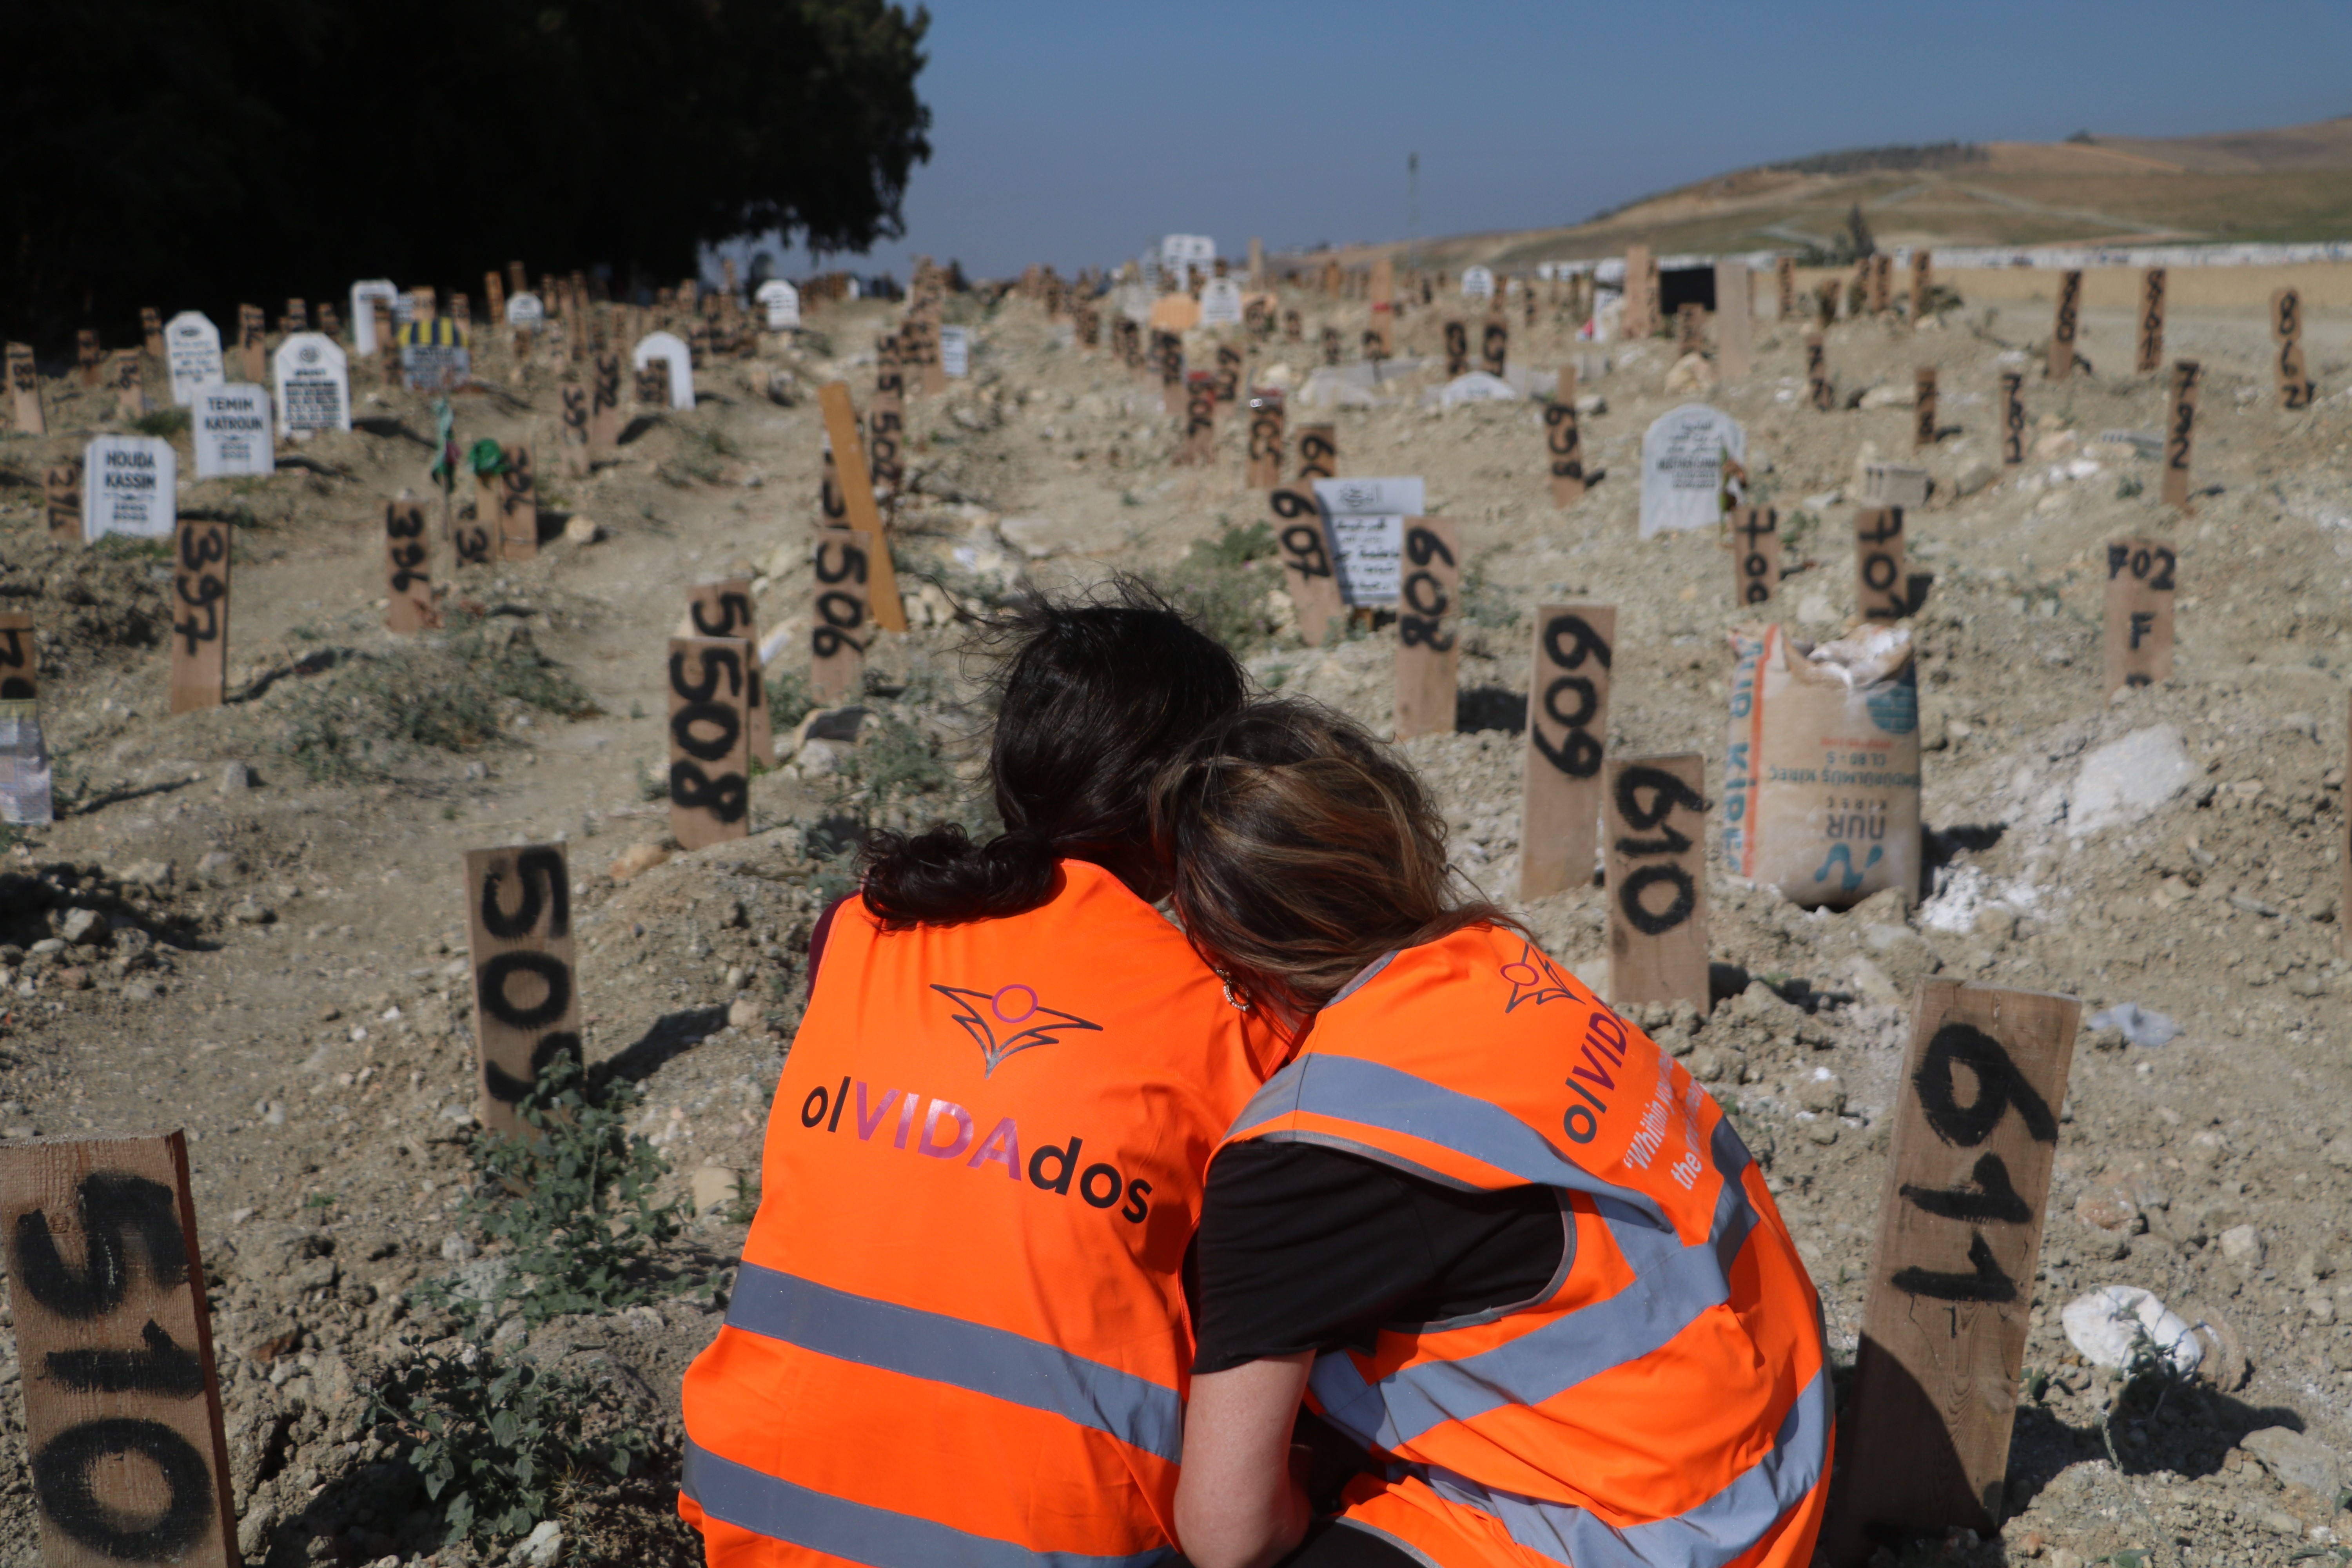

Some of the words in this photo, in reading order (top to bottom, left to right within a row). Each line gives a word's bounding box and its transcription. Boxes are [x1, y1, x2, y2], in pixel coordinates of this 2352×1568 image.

[105, 451, 156, 467] HOUDA
[175, 526, 225, 657] 397
[814, 542, 868, 658] 506
[1270, 489, 1331, 587] 607
[1402, 526, 1456, 652] 608
[670, 647, 748, 823] 508
[1533, 614, 1612, 778] 609
[1614, 764, 1708, 935] 610
[800, 1074, 1153, 1224] olVIDAdos
[1670, 1151, 1702, 1191] the
[1891, 1022, 2060, 1303] 611
[15, 1172, 214, 1561] 510
